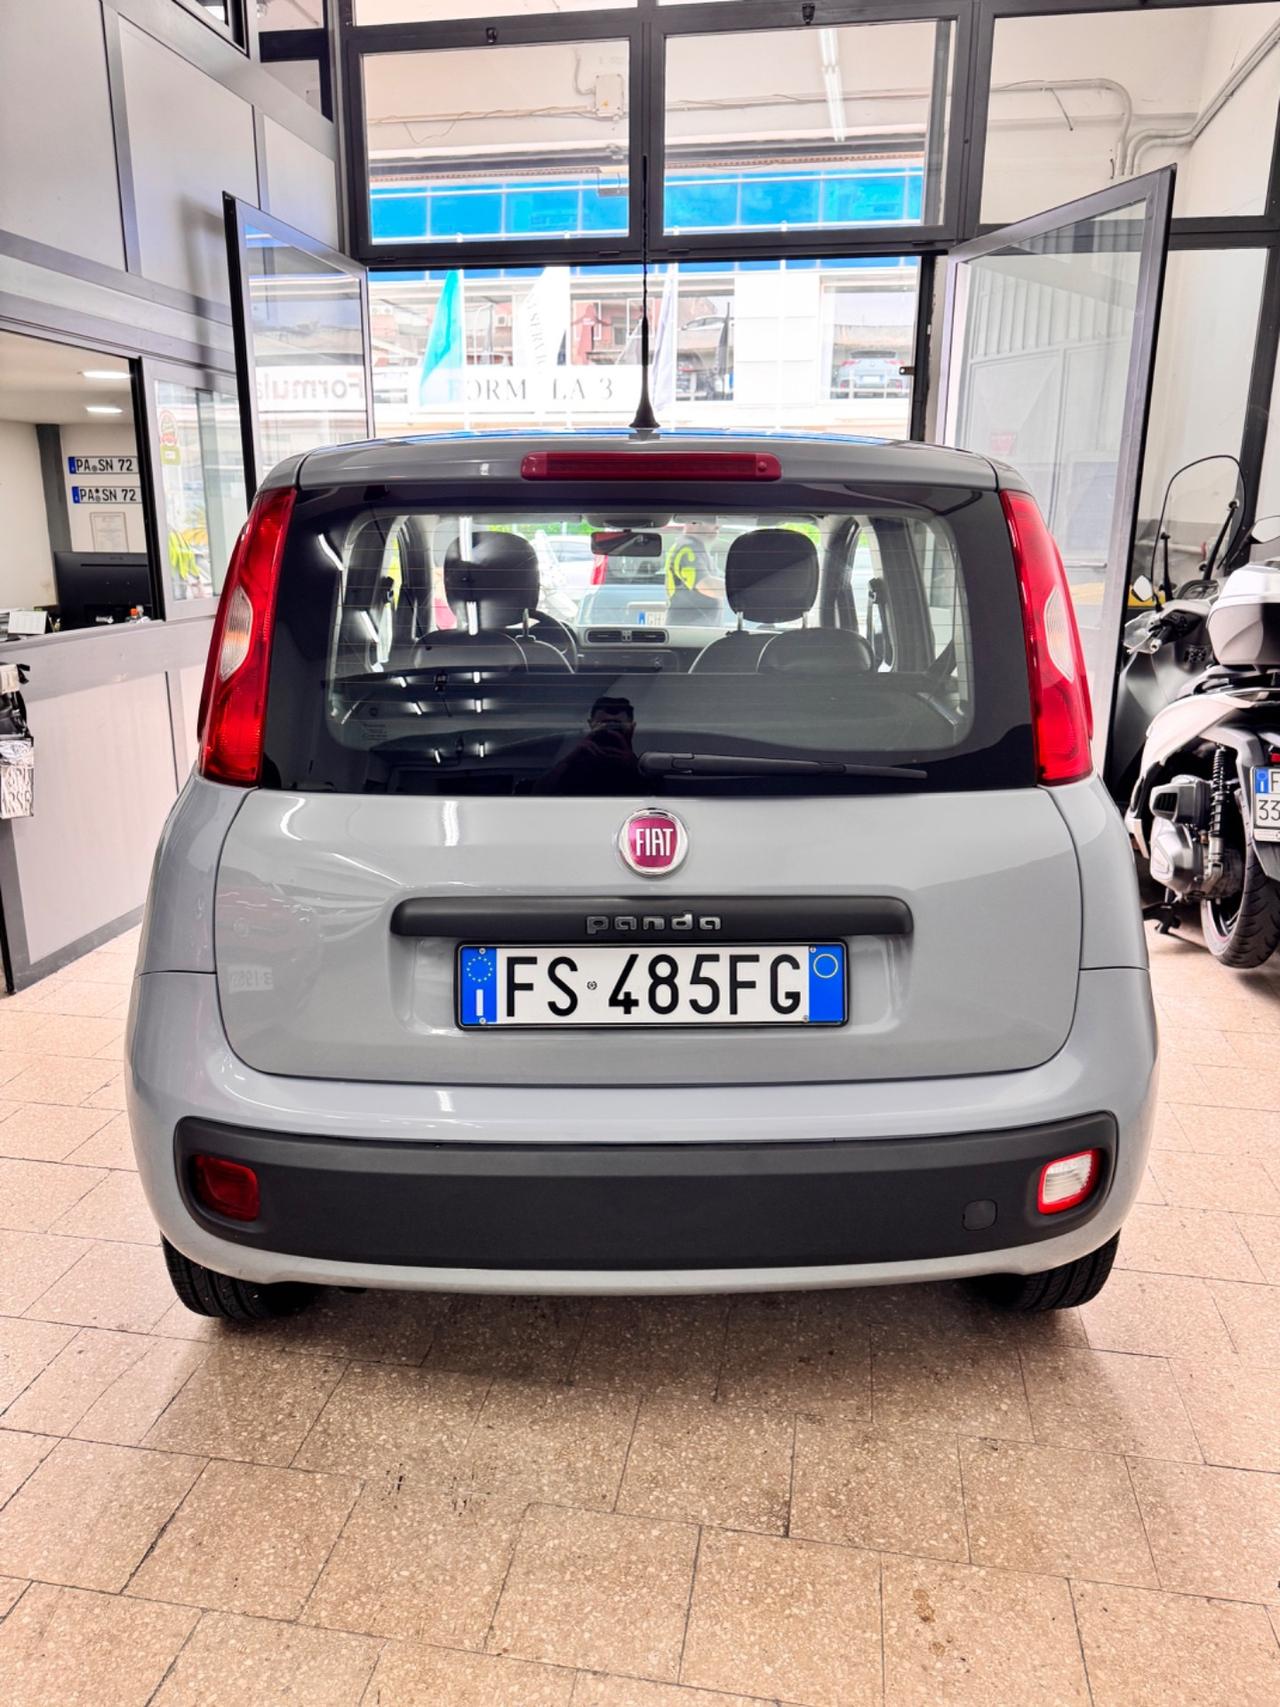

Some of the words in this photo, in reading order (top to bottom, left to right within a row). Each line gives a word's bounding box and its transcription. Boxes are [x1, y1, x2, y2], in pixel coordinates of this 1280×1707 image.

[598, 377, 613, 398] 3
[76, 458, 91, 472] PA
[98, 458, 113, 472] SN
[118, 458, 133, 472] 72
[80, 488, 95, 502] PA
[102, 488, 118, 502] SN
[121, 488, 137, 502] 72
[635, 827, 674, 857] FIAT
[585, 911, 723, 935] panda
[505, 955, 579, 1019] FS
[607, 950, 803, 1018] 485FG
